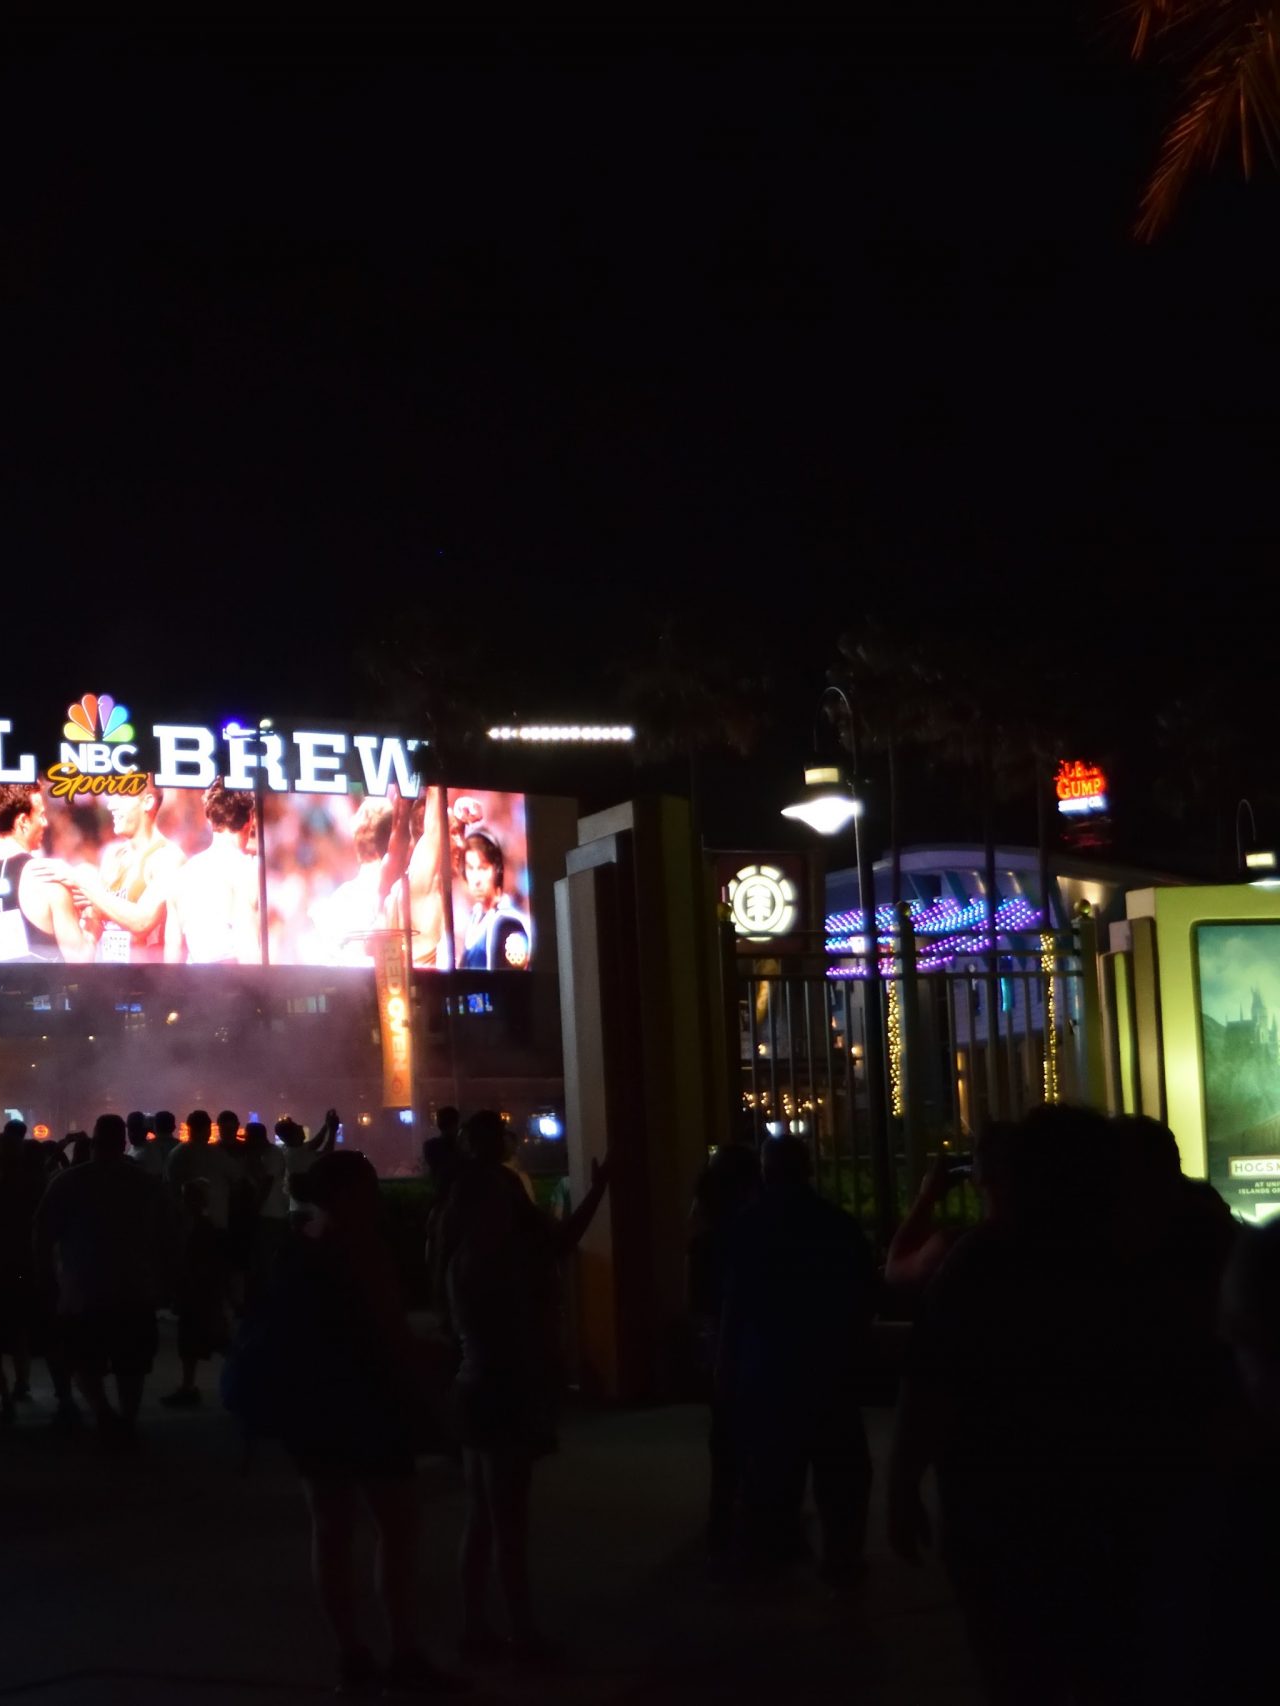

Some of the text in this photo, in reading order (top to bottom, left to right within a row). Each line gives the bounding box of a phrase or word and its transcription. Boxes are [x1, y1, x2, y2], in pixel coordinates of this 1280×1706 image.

[60, 743, 138, 774] NBC
[152, 725, 429, 798] BREW
[47, 762, 147, 801] Sports
[1056, 778, 1101, 799] GUMP
